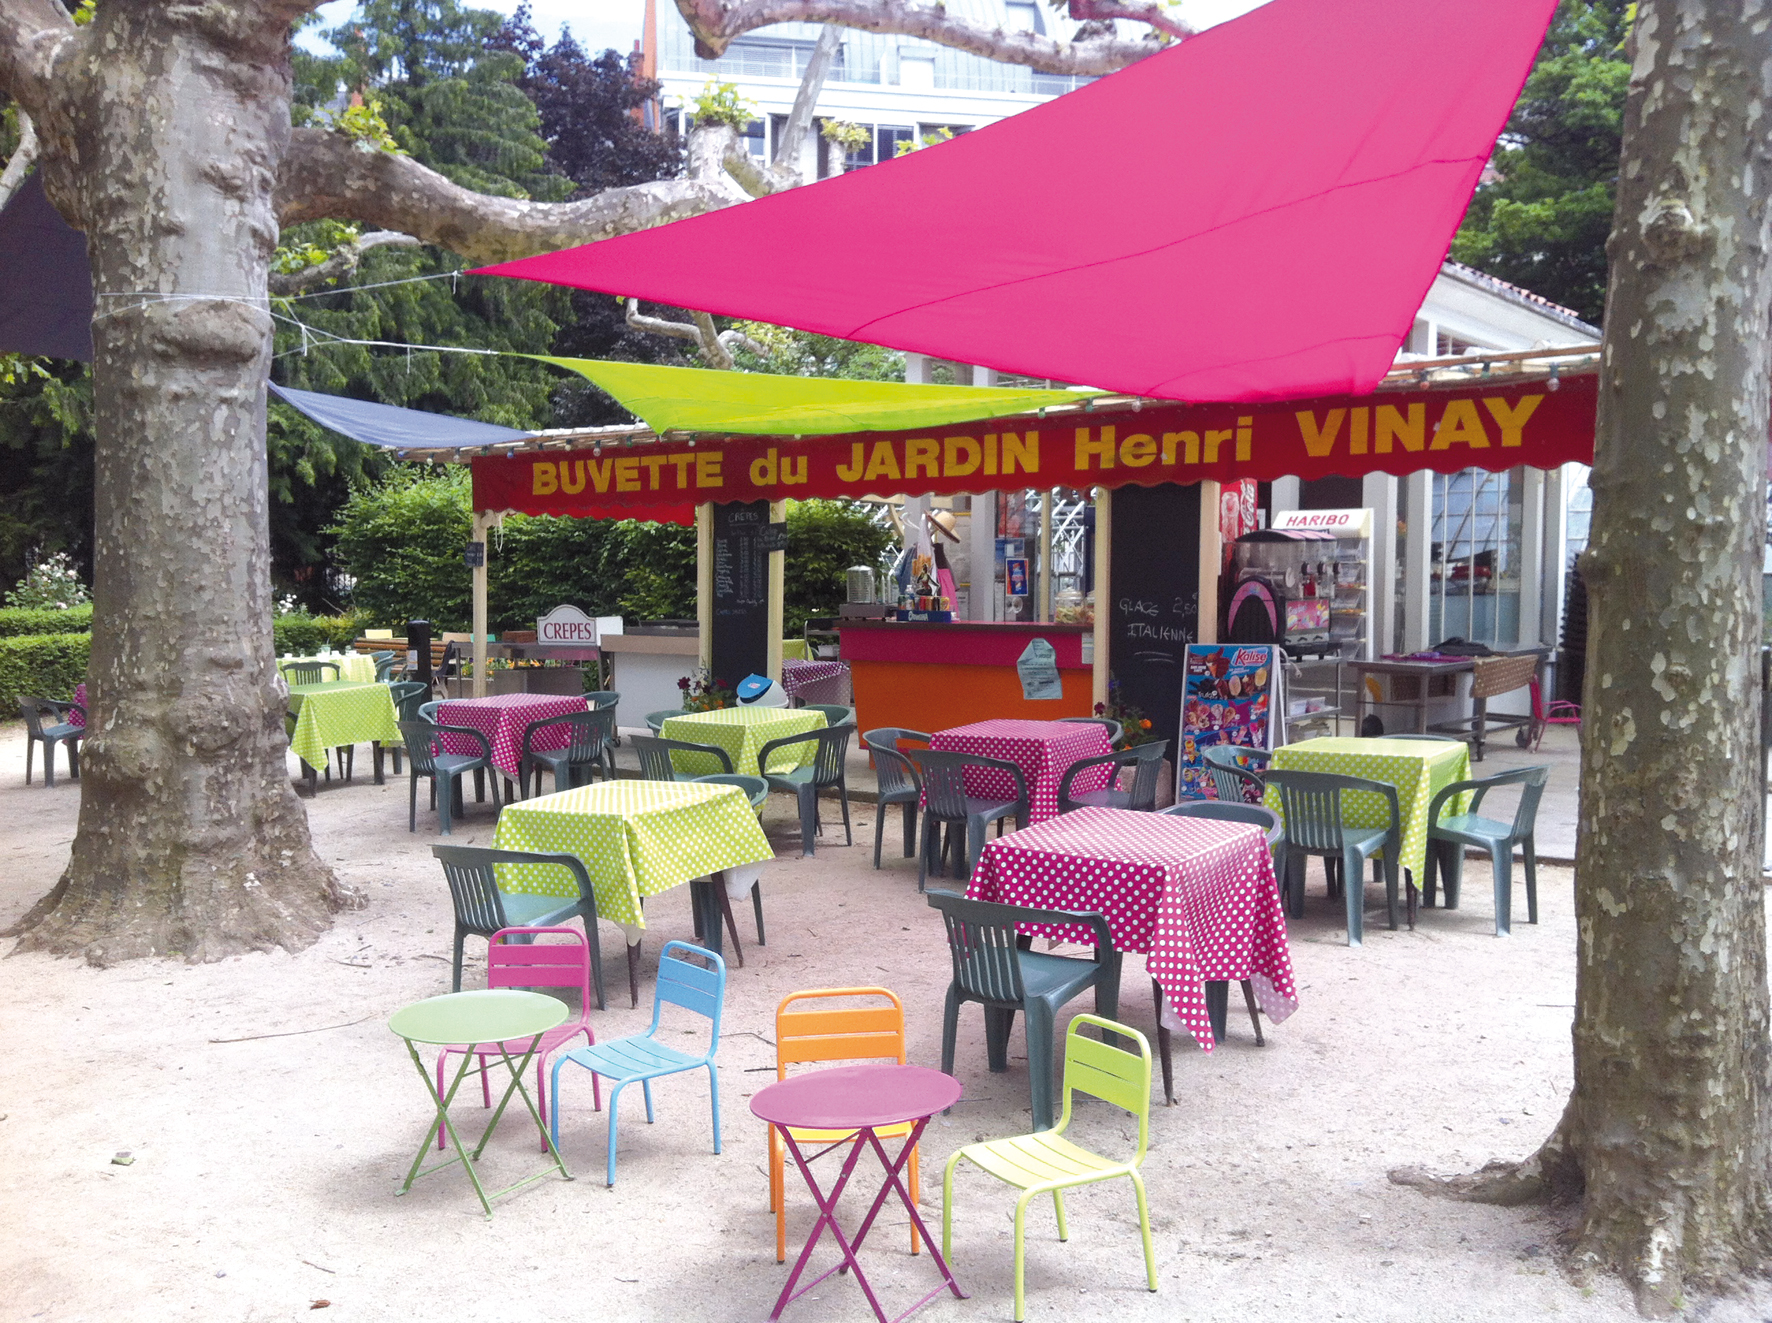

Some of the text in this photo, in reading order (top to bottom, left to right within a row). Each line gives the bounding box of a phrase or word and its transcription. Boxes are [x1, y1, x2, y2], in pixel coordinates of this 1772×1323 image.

[532, 394, 1546, 496] BUVETTE du JARDIN Henri VINAY
[1286, 514, 1349, 527] HARIBO
[1119, 598, 1159, 617] GLACE
[543, 622, 592, 640] CREPES
[1127, 623, 1194, 644] ITALIENNE
[1234, 648, 1267, 666] Kalise
